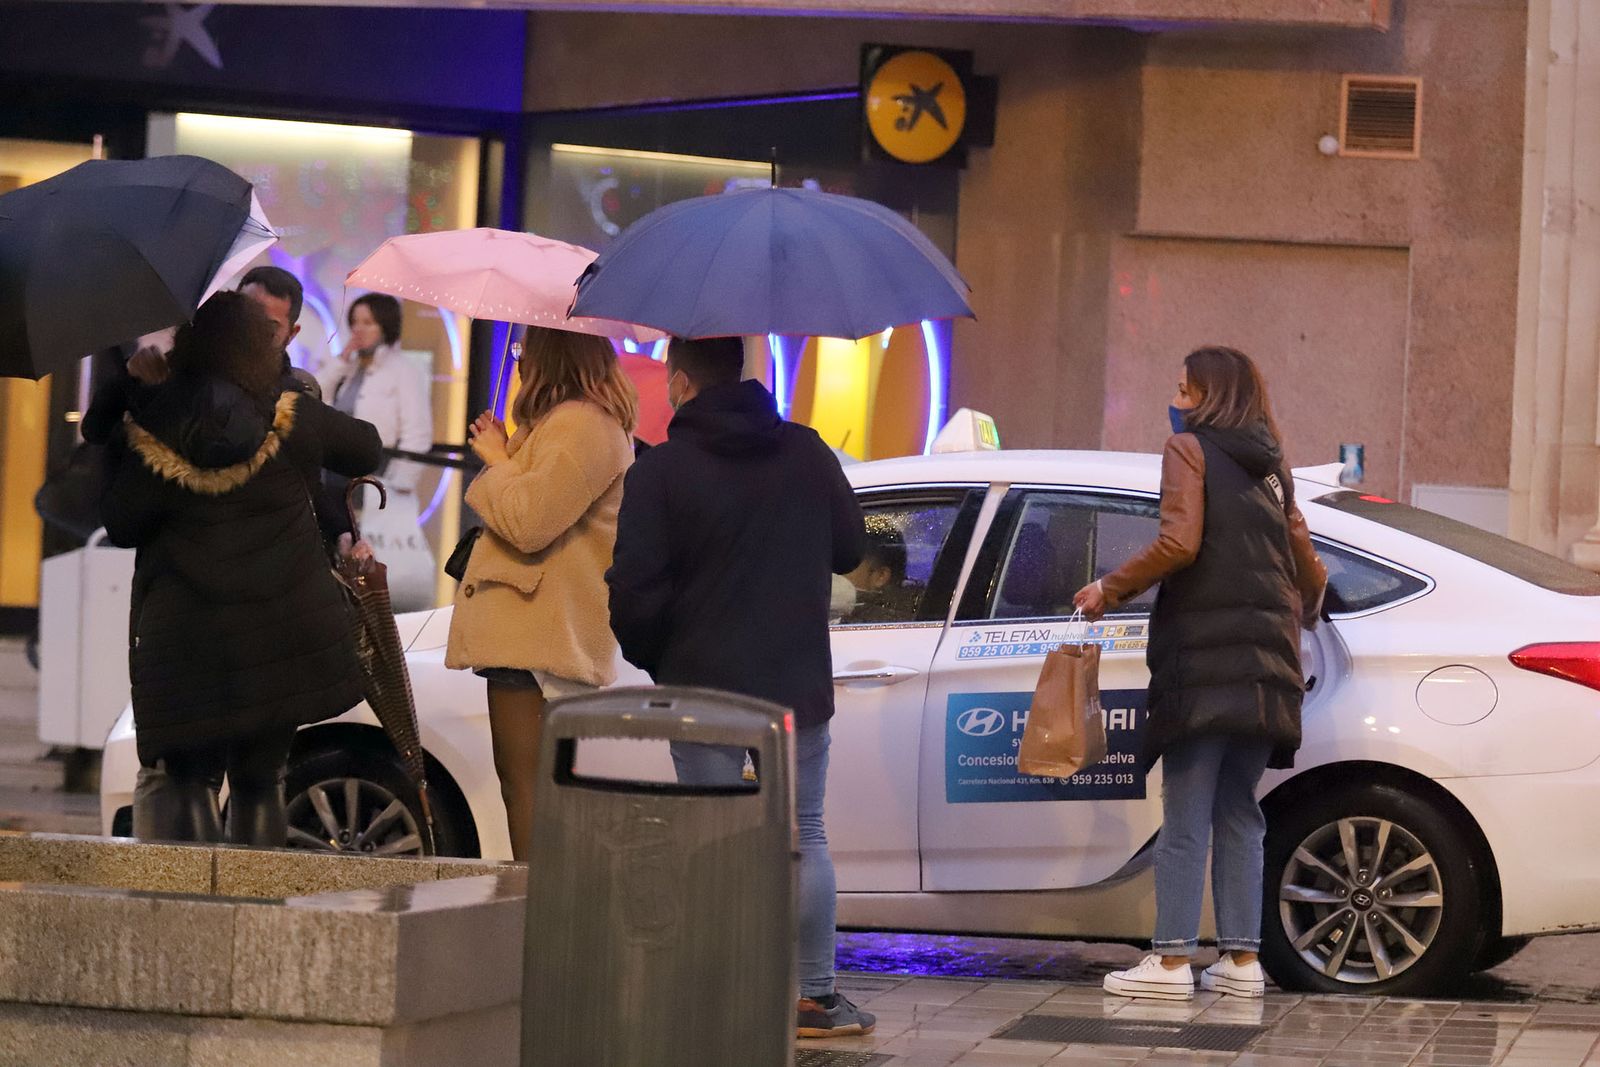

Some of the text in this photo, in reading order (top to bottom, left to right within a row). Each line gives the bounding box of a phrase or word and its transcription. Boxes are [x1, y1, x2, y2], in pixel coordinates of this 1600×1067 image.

[984, 630, 1051, 643] TELETAXI
[961, 646, 981, 657] 959
[983, 645, 997, 656] 25
[1000, 645, 1014, 655] 00
[1016, 644, 1031, 654] 22
[1040, 643, 1060, 653] 959
[1072, 775, 1092, 785] 959
[1094, 774, 1113, 785] 235
[1115, 774, 1134, 784] 013
